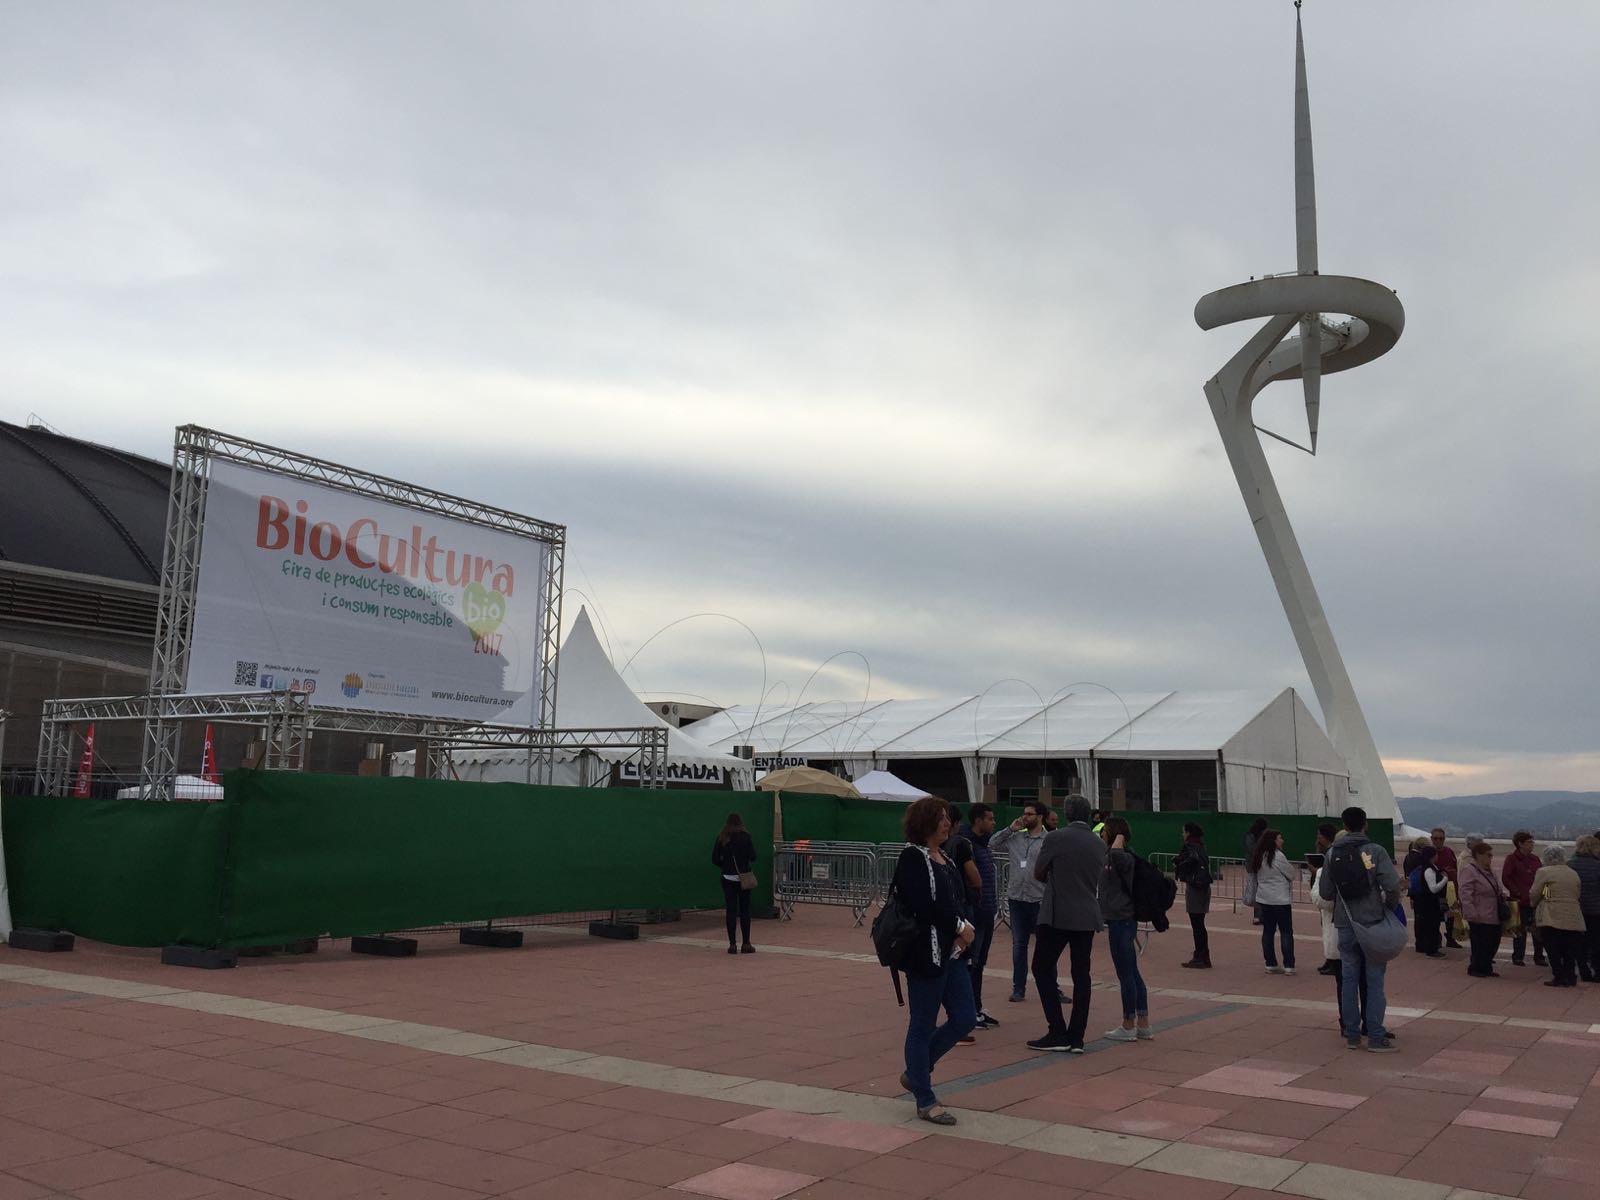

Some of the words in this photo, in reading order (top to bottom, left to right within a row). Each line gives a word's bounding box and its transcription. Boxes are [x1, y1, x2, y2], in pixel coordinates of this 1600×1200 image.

[256, 495, 514, 597] BioCultura
[281, 559, 312, 580] fira
[315, 567, 331, 583] de
[334, 573, 401, 598] productes
[322, 592, 328, 606] i
[383, 604, 454, 628] responsable
[467, 591, 501, 624] bio
[474, 633, 503, 656] 2017
[431, 690, 515, 709] www.biocultura.org
[755, 757, 805, 767] ENTRADA
